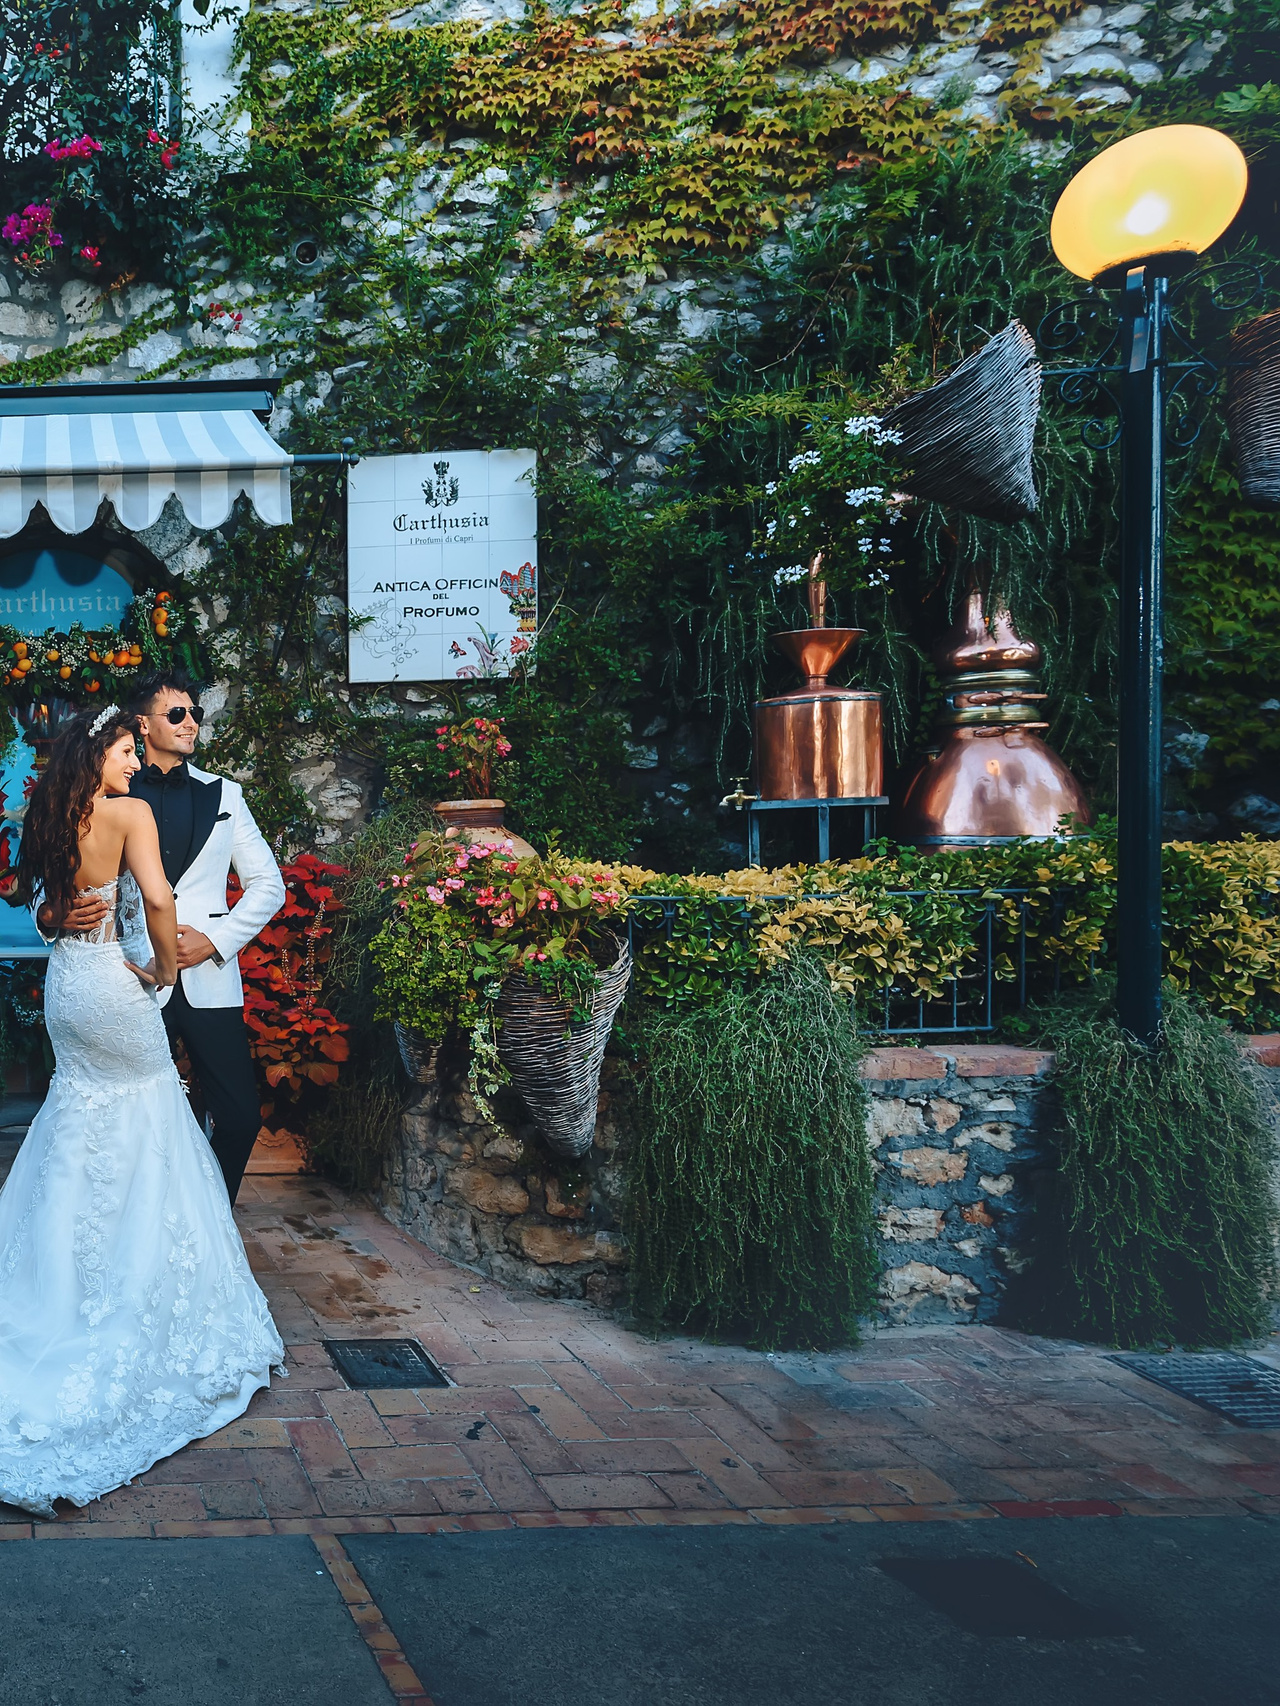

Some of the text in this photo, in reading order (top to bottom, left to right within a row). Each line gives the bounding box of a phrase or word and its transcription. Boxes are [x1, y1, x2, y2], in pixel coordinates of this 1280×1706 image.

[393, 511, 490, 534] Carthusia
[415, 536, 443, 545] Profumi
[445, 535, 452, 543] di
[454, 534, 474, 544] Capri
[373, 578, 510, 593] ANTICA OFFICINA
[403, 606, 480, 618] PROFUMO
